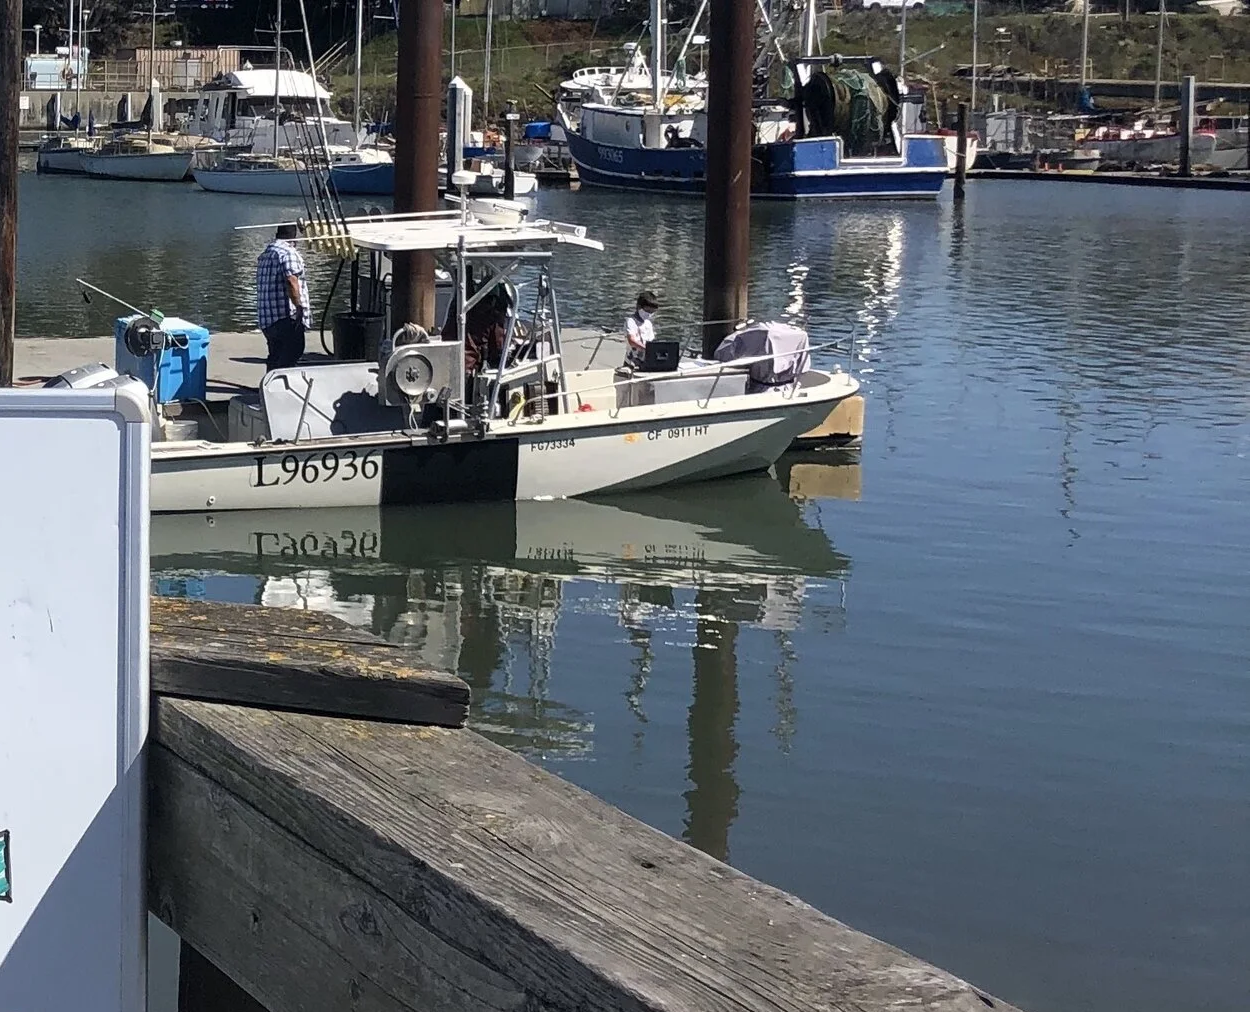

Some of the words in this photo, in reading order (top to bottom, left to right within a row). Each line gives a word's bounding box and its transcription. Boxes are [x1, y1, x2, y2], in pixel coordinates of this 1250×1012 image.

[647, 431, 662, 441] CF
[667, 428, 692, 439] 0911
[695, 425, 710, 436] HT
[530, 437, 576, 452] FG73334
[253, 449, 379, 487] L96936
